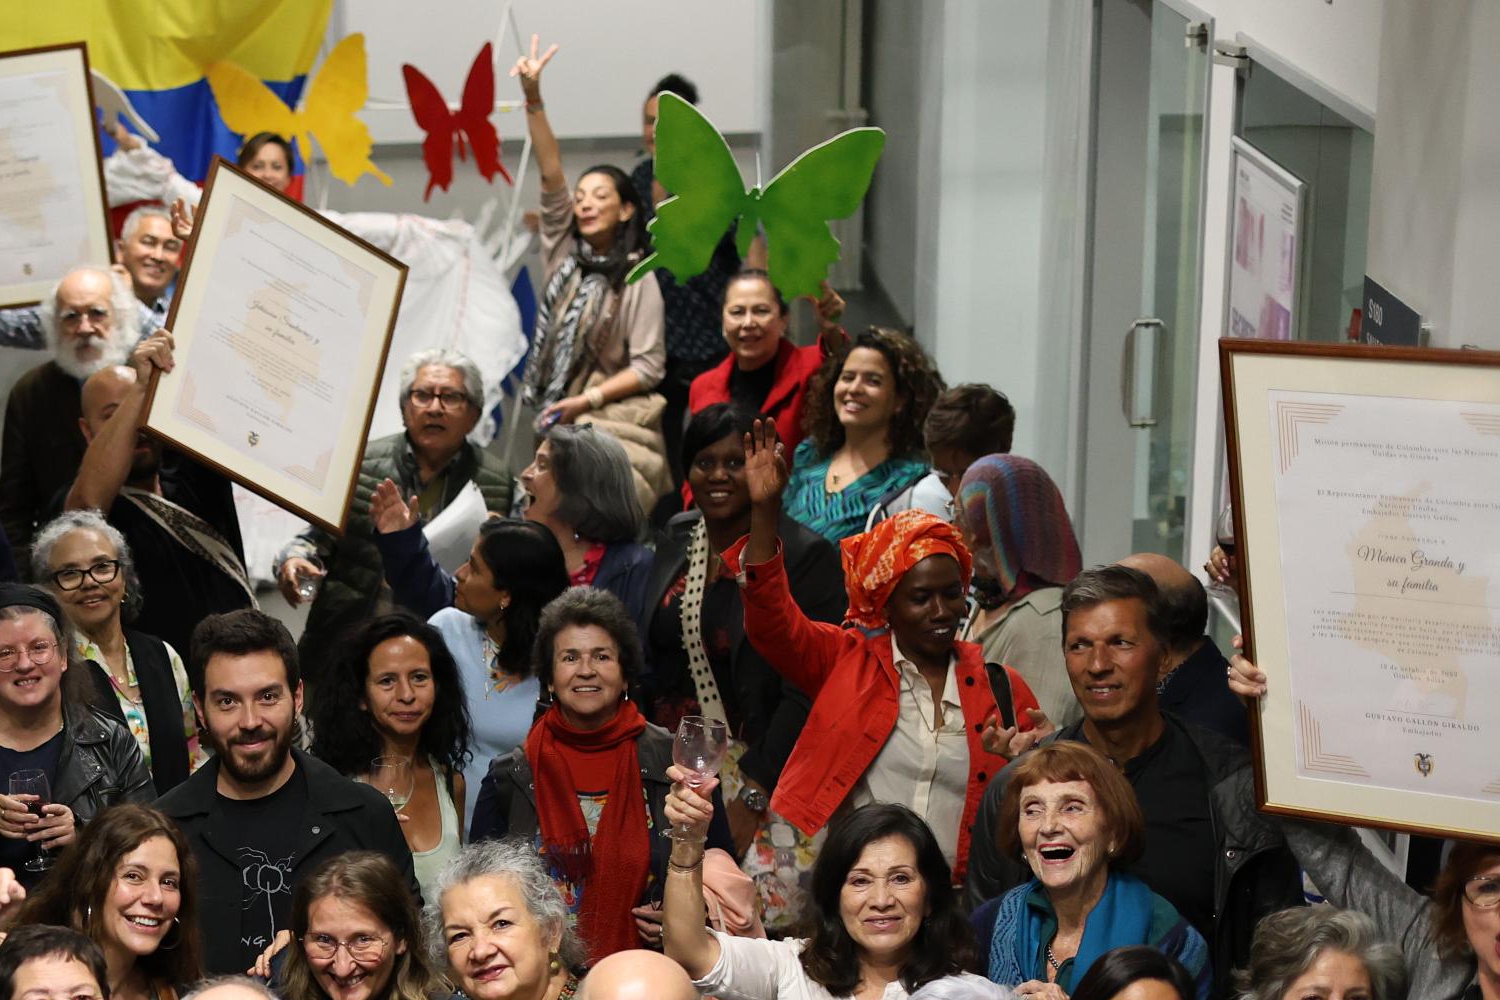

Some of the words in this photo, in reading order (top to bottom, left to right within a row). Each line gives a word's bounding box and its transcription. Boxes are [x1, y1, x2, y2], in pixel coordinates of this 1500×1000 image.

[1357, 545, 1407, 565] Mónica
[1455, 560, 1466, 575] y
[1386, 579, 1398, 588] su
[1401, 576, 1439, 594] familia
